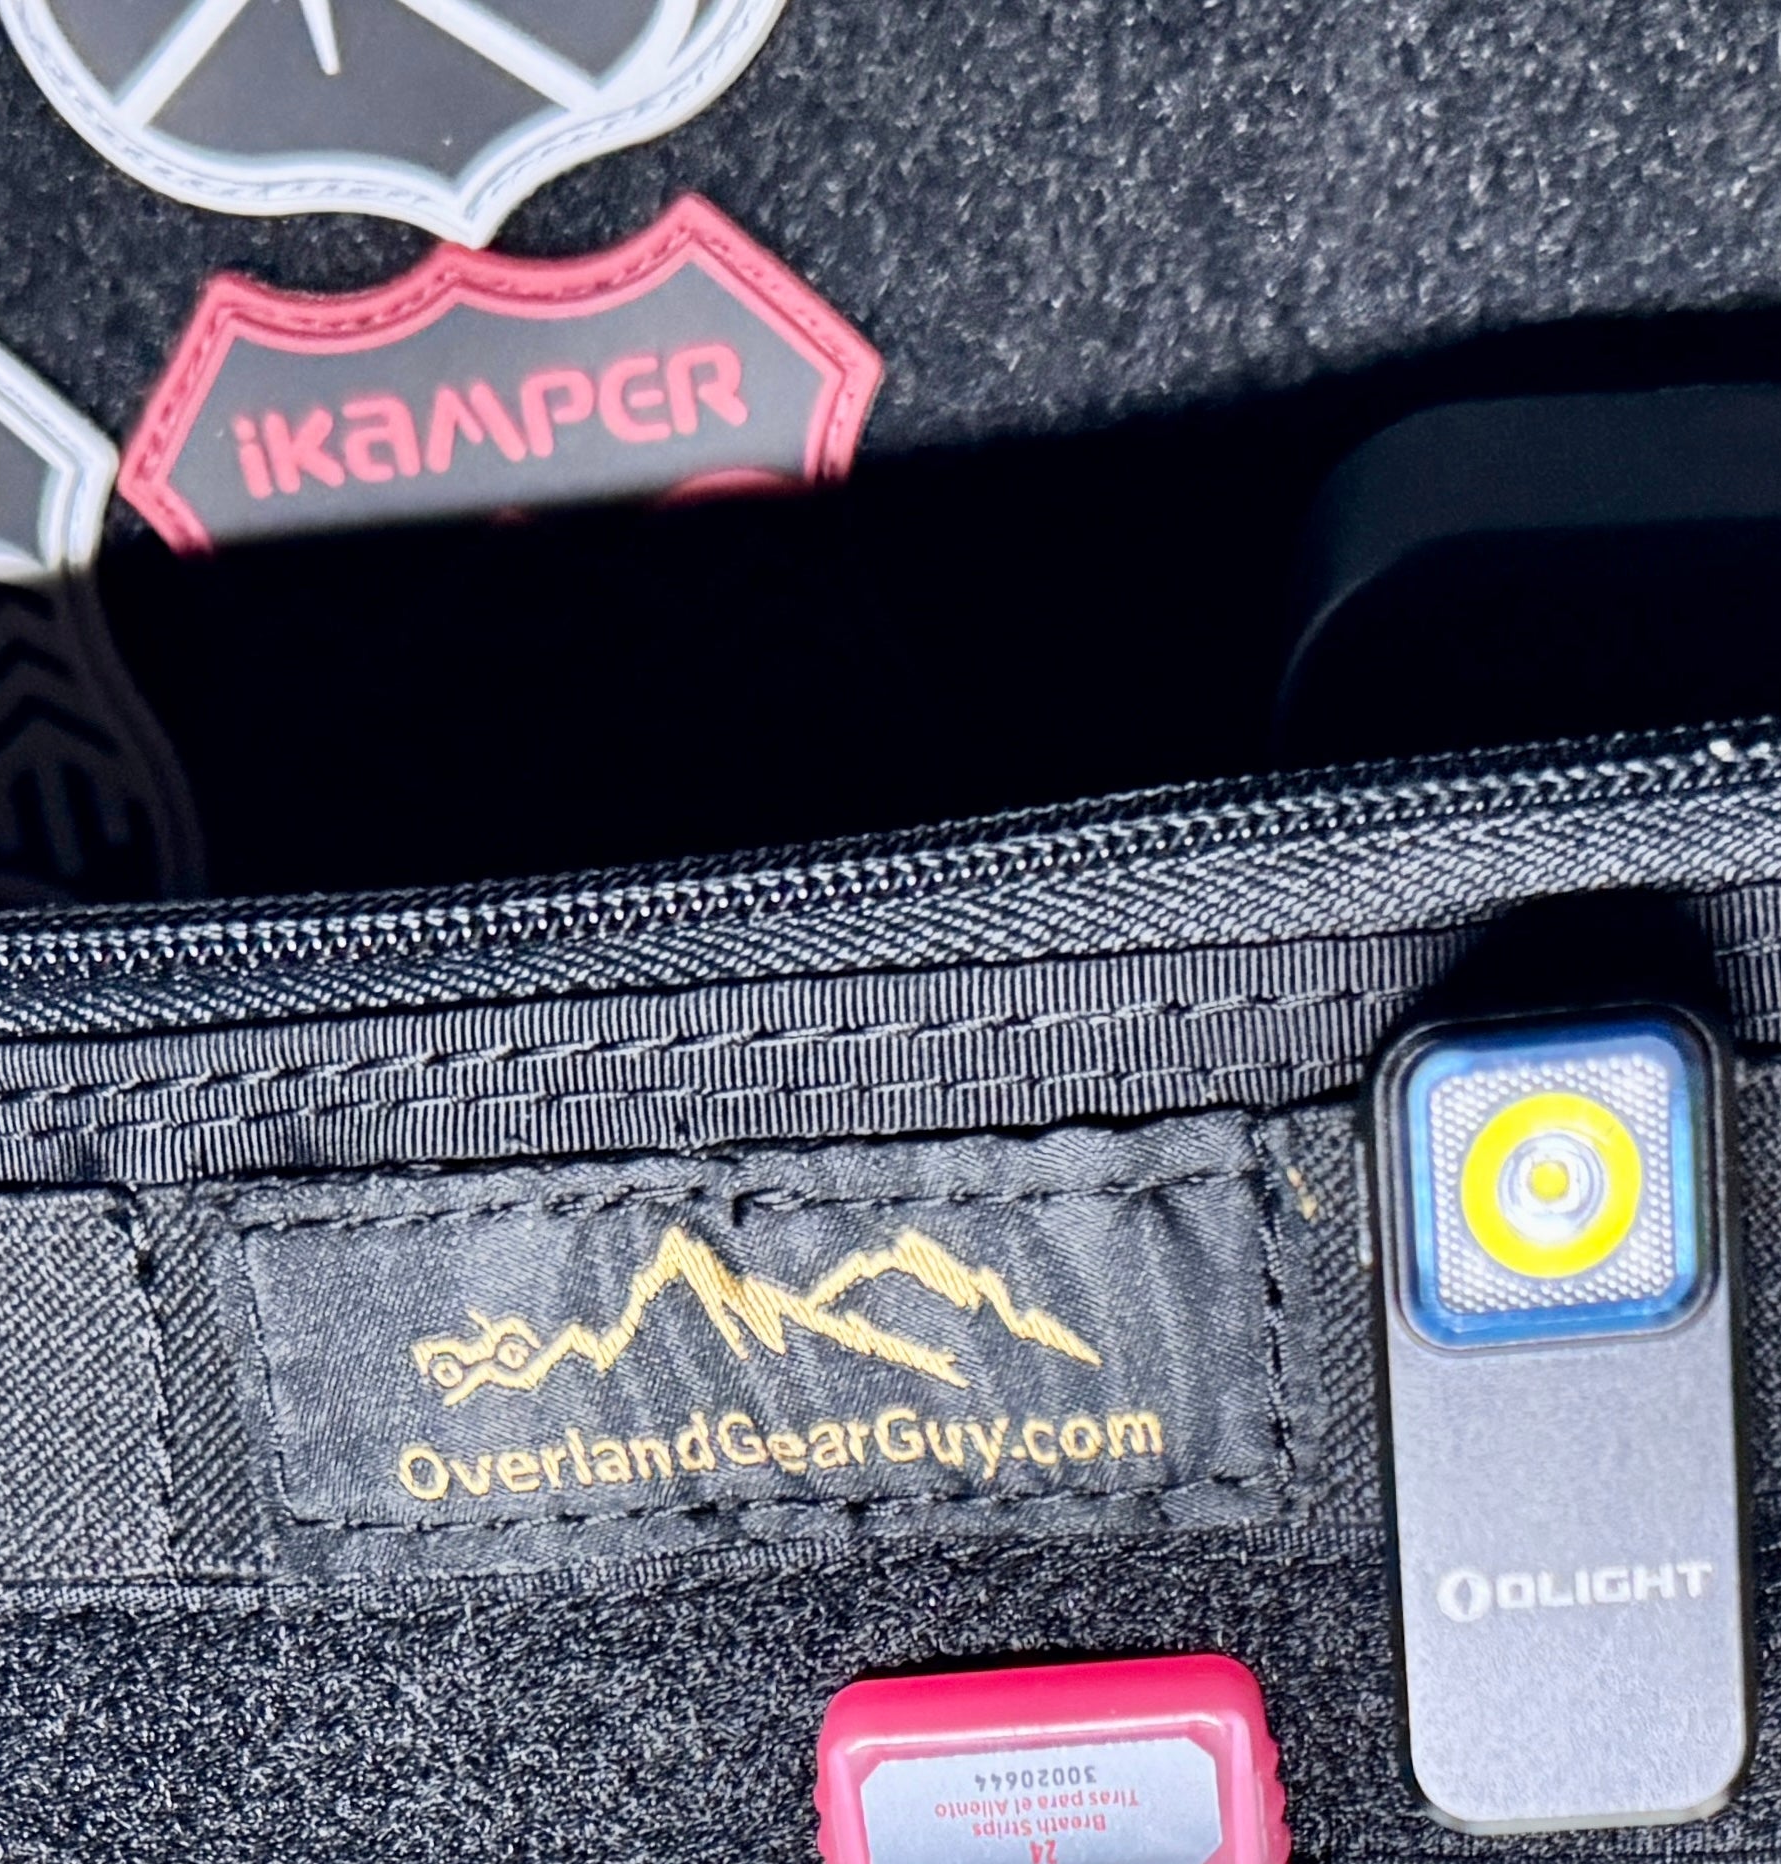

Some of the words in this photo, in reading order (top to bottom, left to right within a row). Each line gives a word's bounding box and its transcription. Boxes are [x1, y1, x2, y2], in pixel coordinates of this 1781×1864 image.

[398, 1407, 1165, 1501] OverlandGearGuy.com
[1495, 1560, 1713, 1611] OLIGHT
[974, 1764, 1097, 1792] 30020644
[1015, 1796, 1033, 1813] el
[1037, 1789, 1083, 1807] para
[971, 1819, 1033, 1841] Strips
[1035, 1814, 1107, 1834] Breath
